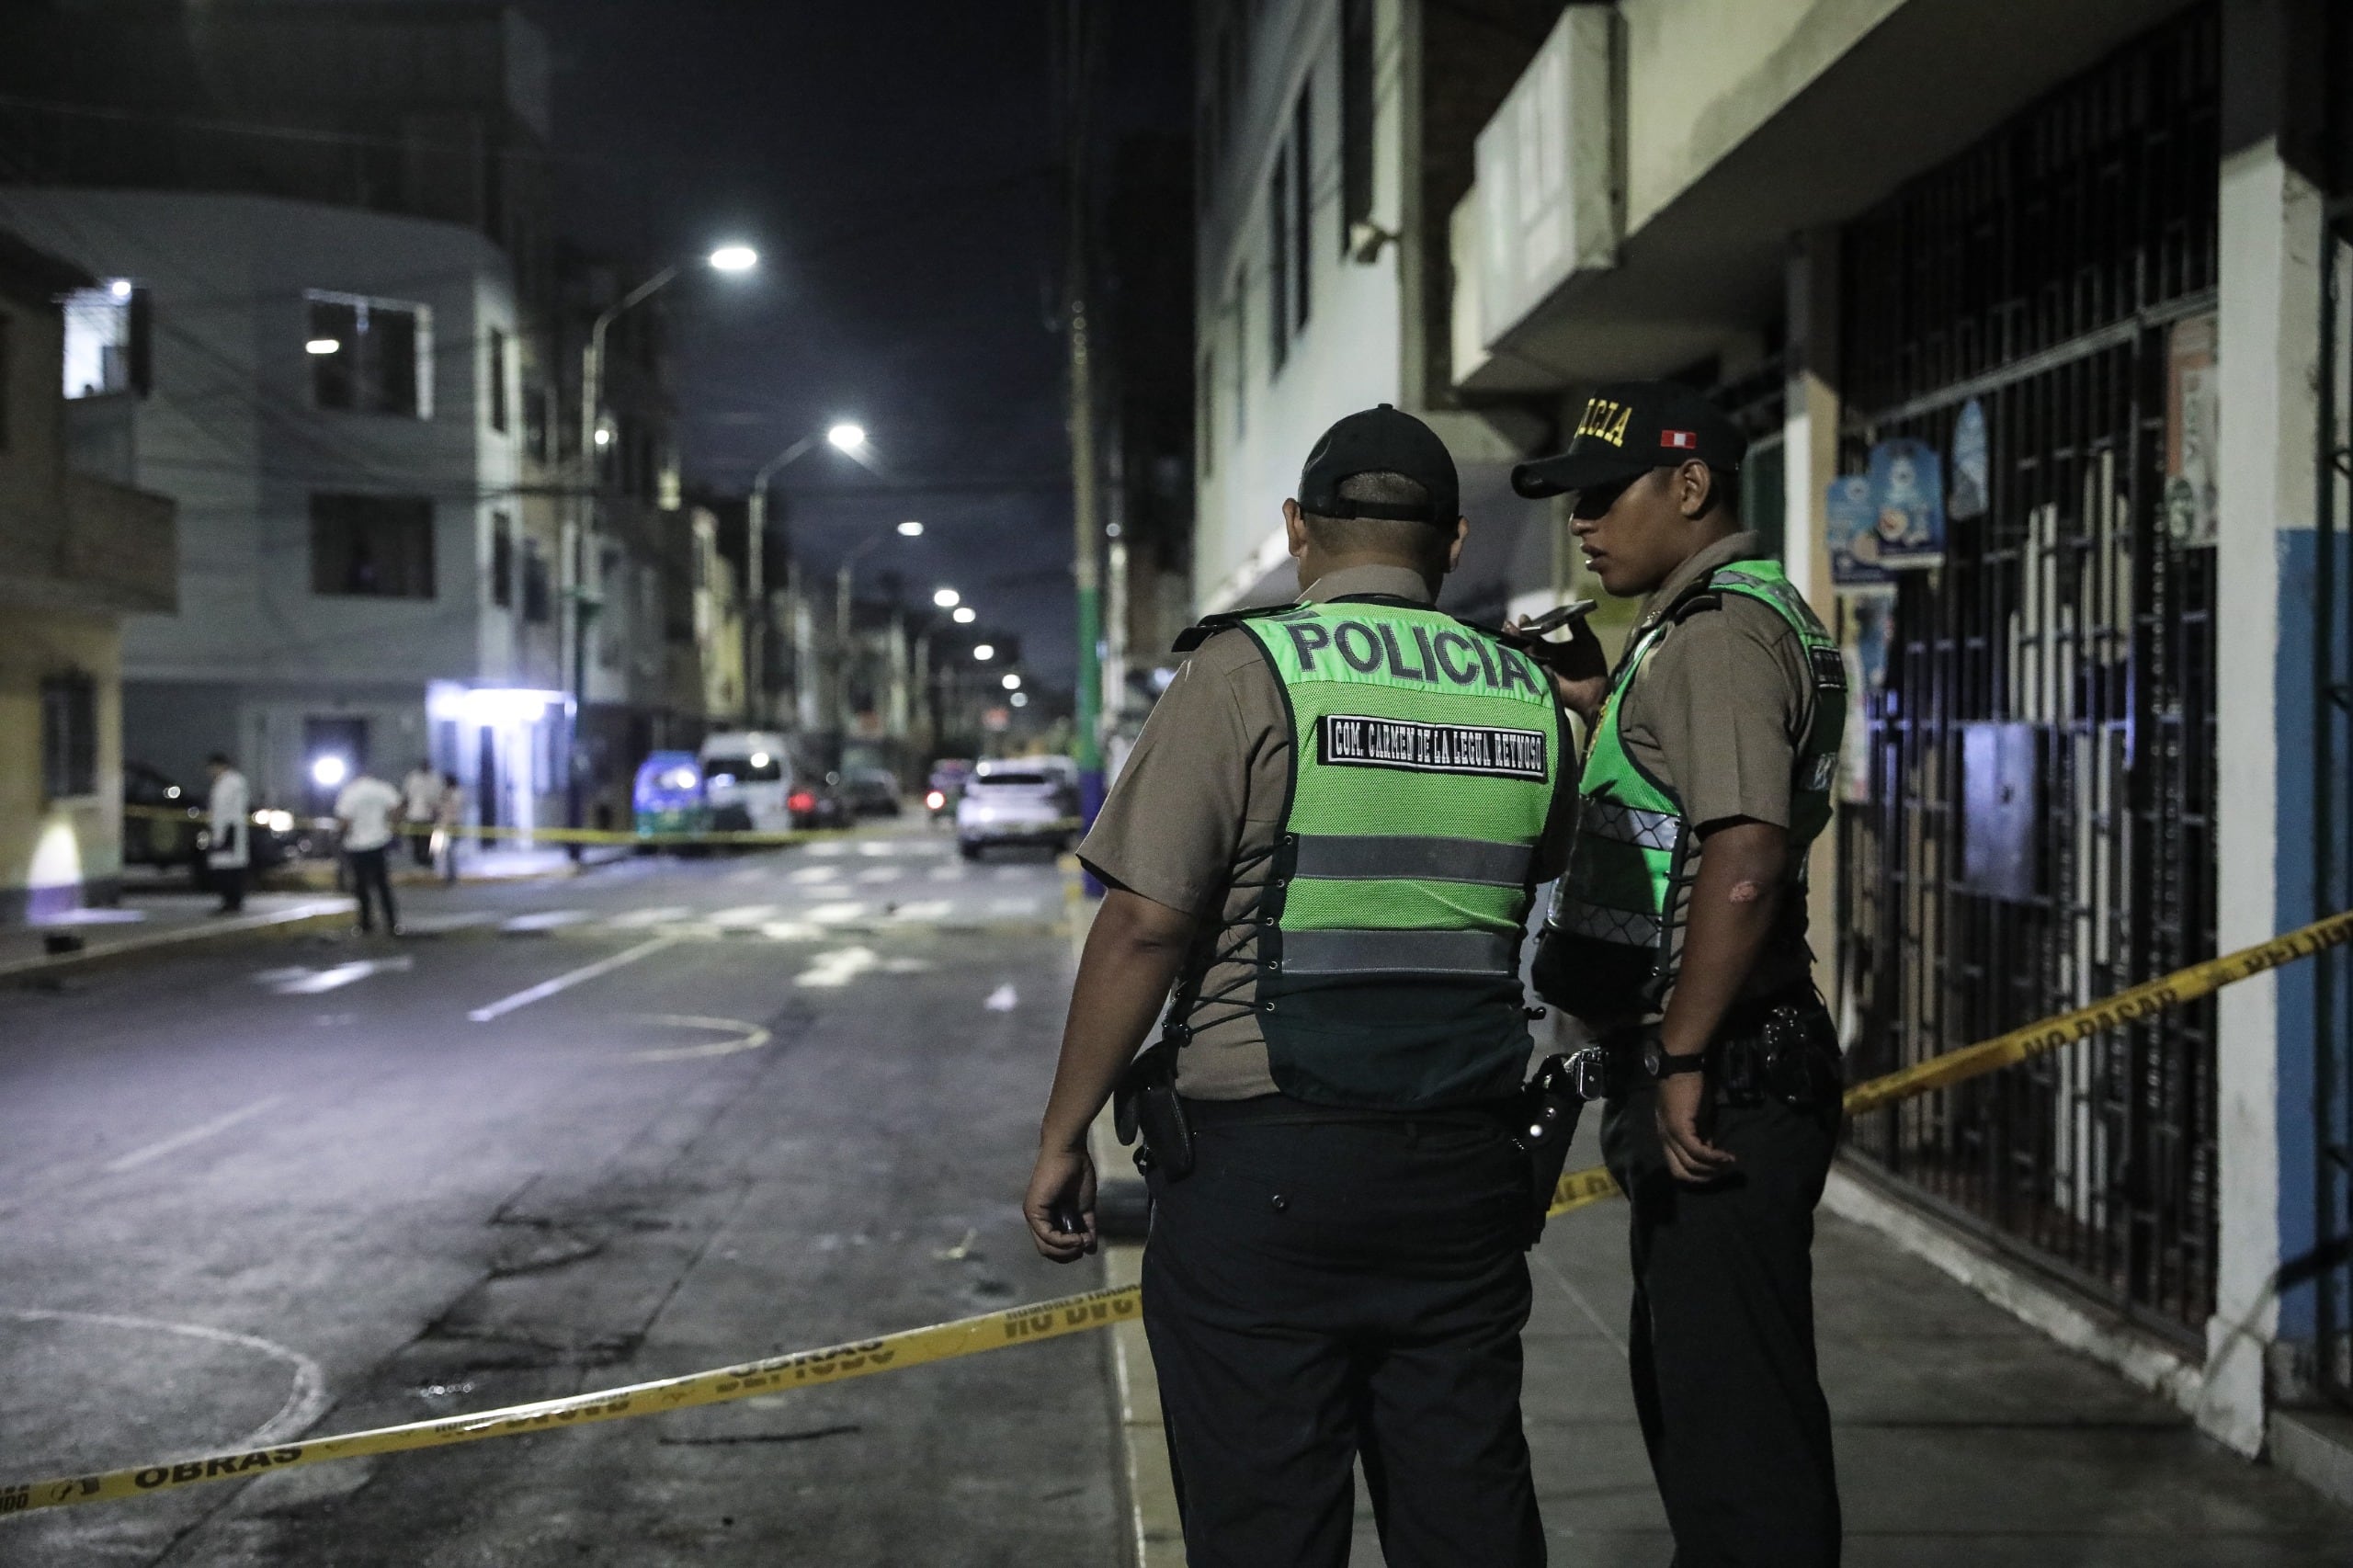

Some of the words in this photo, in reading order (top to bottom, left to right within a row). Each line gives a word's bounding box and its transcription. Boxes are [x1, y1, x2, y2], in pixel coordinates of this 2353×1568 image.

[1577, 398, 1632, 447] ICIA
[1286, 620, 1544, 697] POLICIA
[1336, 721, 1364, 757] COM.
[1368, 722, 1415, 761] CARMEN
[1416, 729, 1431, 763] DE
[1434, 730, 1449, 765] LA
[1453, 731, 1491, 767] LEGUA
[1495, 733, 1542, 771] REYNOSO
[135, 1446, 302, 1490] OBRAS
